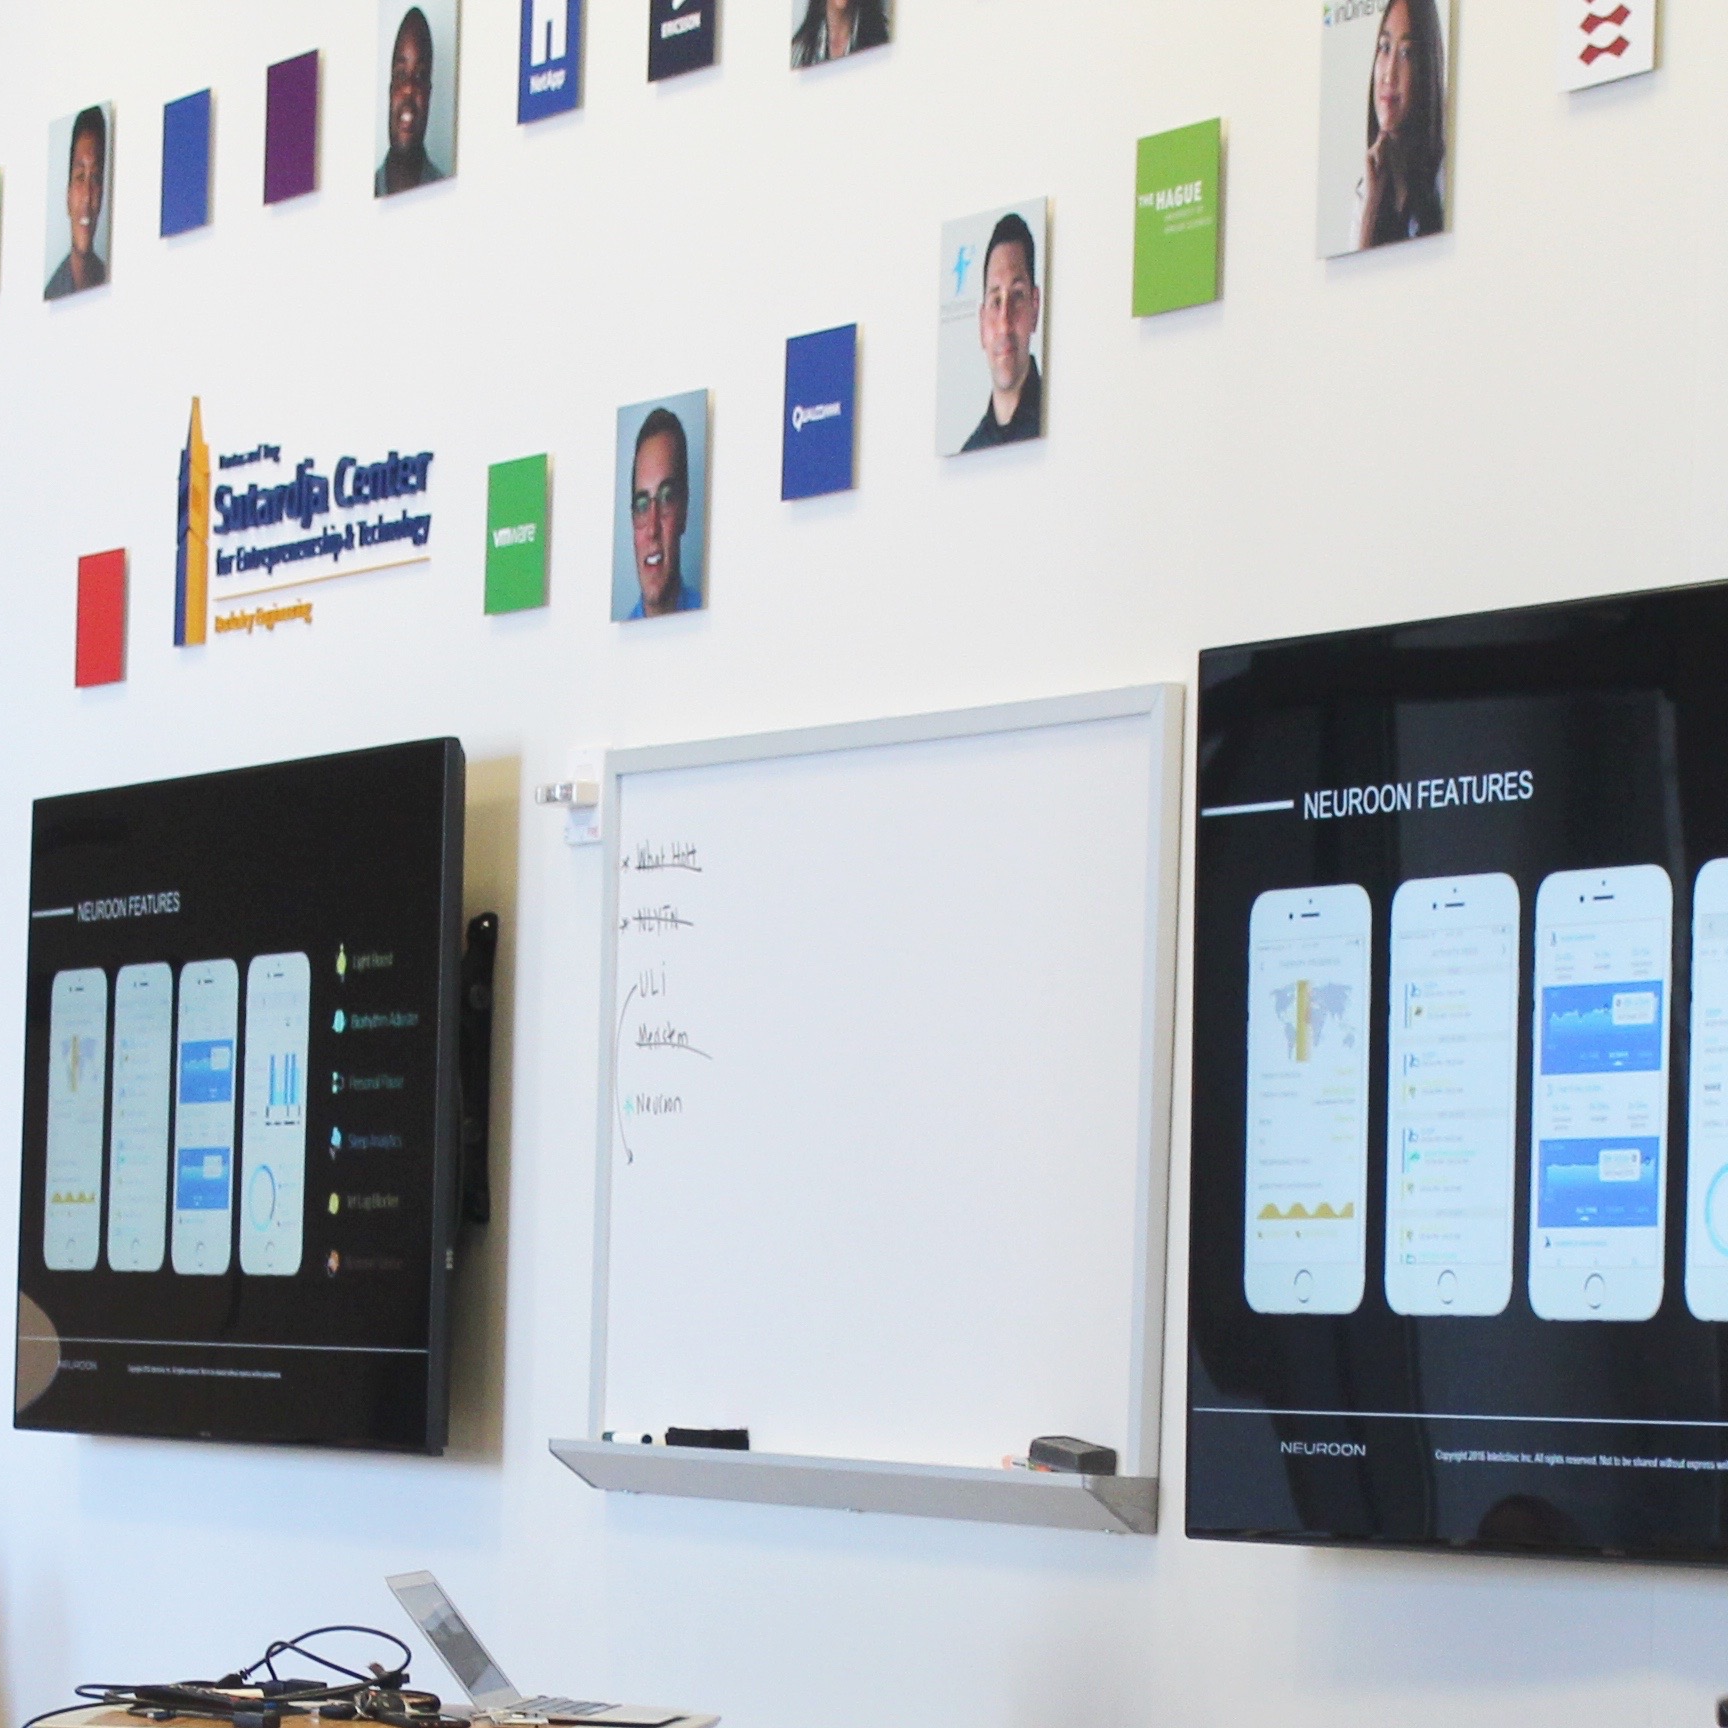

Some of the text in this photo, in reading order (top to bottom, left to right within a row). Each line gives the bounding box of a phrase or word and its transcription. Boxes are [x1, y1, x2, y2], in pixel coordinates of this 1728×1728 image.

[1155, 180, 1202, 211] HAGUE
[213, 451, 434, 535] Sutardja Center
[216, 549, 236, 577] for
[357, 509, 432, 547] Technology
[493, 522, 537, 549] vmware
[1303, 769, 1534, 820] NEUROON FEATURES
[77, 890, 181, 922] NEUROON FEATURES
[1280, 1440, 1367, 1457] NEUROON
[1435, 1449, 1468, 1464] Copyright
